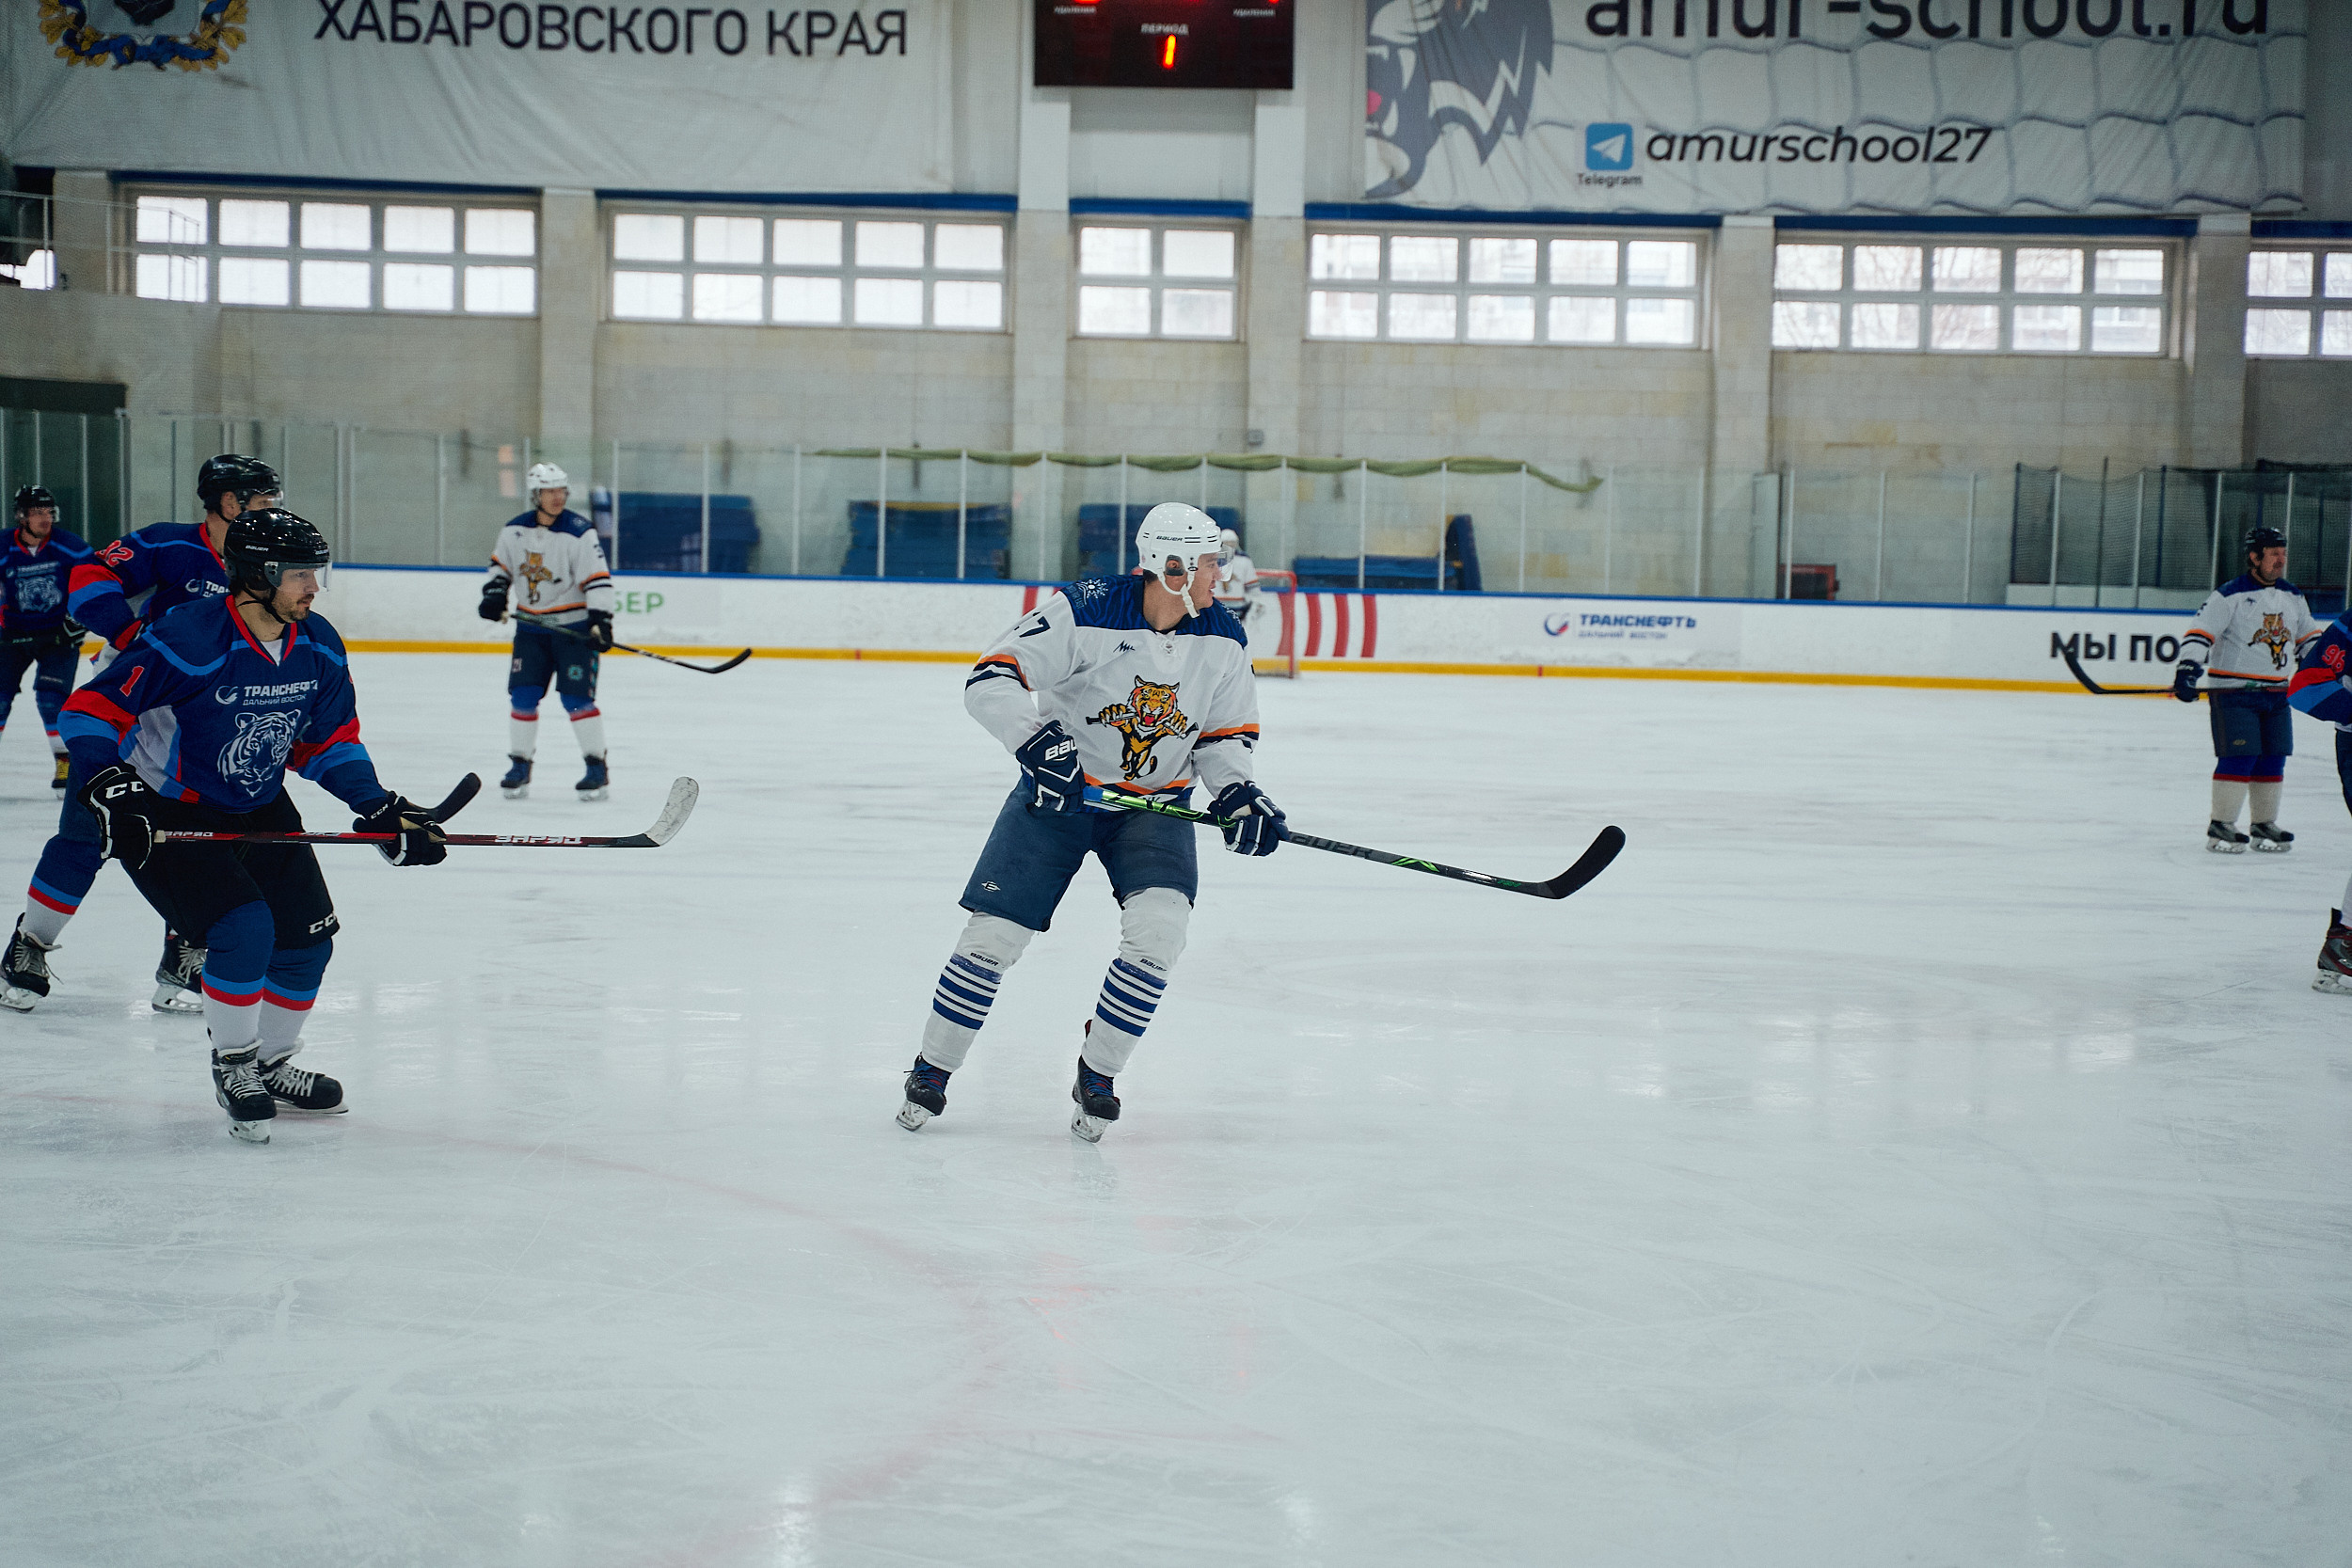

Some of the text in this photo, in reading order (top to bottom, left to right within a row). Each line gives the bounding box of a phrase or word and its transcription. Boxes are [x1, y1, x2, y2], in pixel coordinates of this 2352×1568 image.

[314, 0, 907, 56] ХАБАРОВСКОГО КРАЯ
[1163, 35, 1176, 68] 1
[1645, 125, 1994, 163] amurschool27
[1578, 173, 1643, 188] Telegram
[1580, 614, 1696, 628] ТРАНСНЕФТЬ
[2051, 631, 2117, 660] МЫ
[2321, 644, 2346, 673] 96
[119, 665, 145, 697] 1
